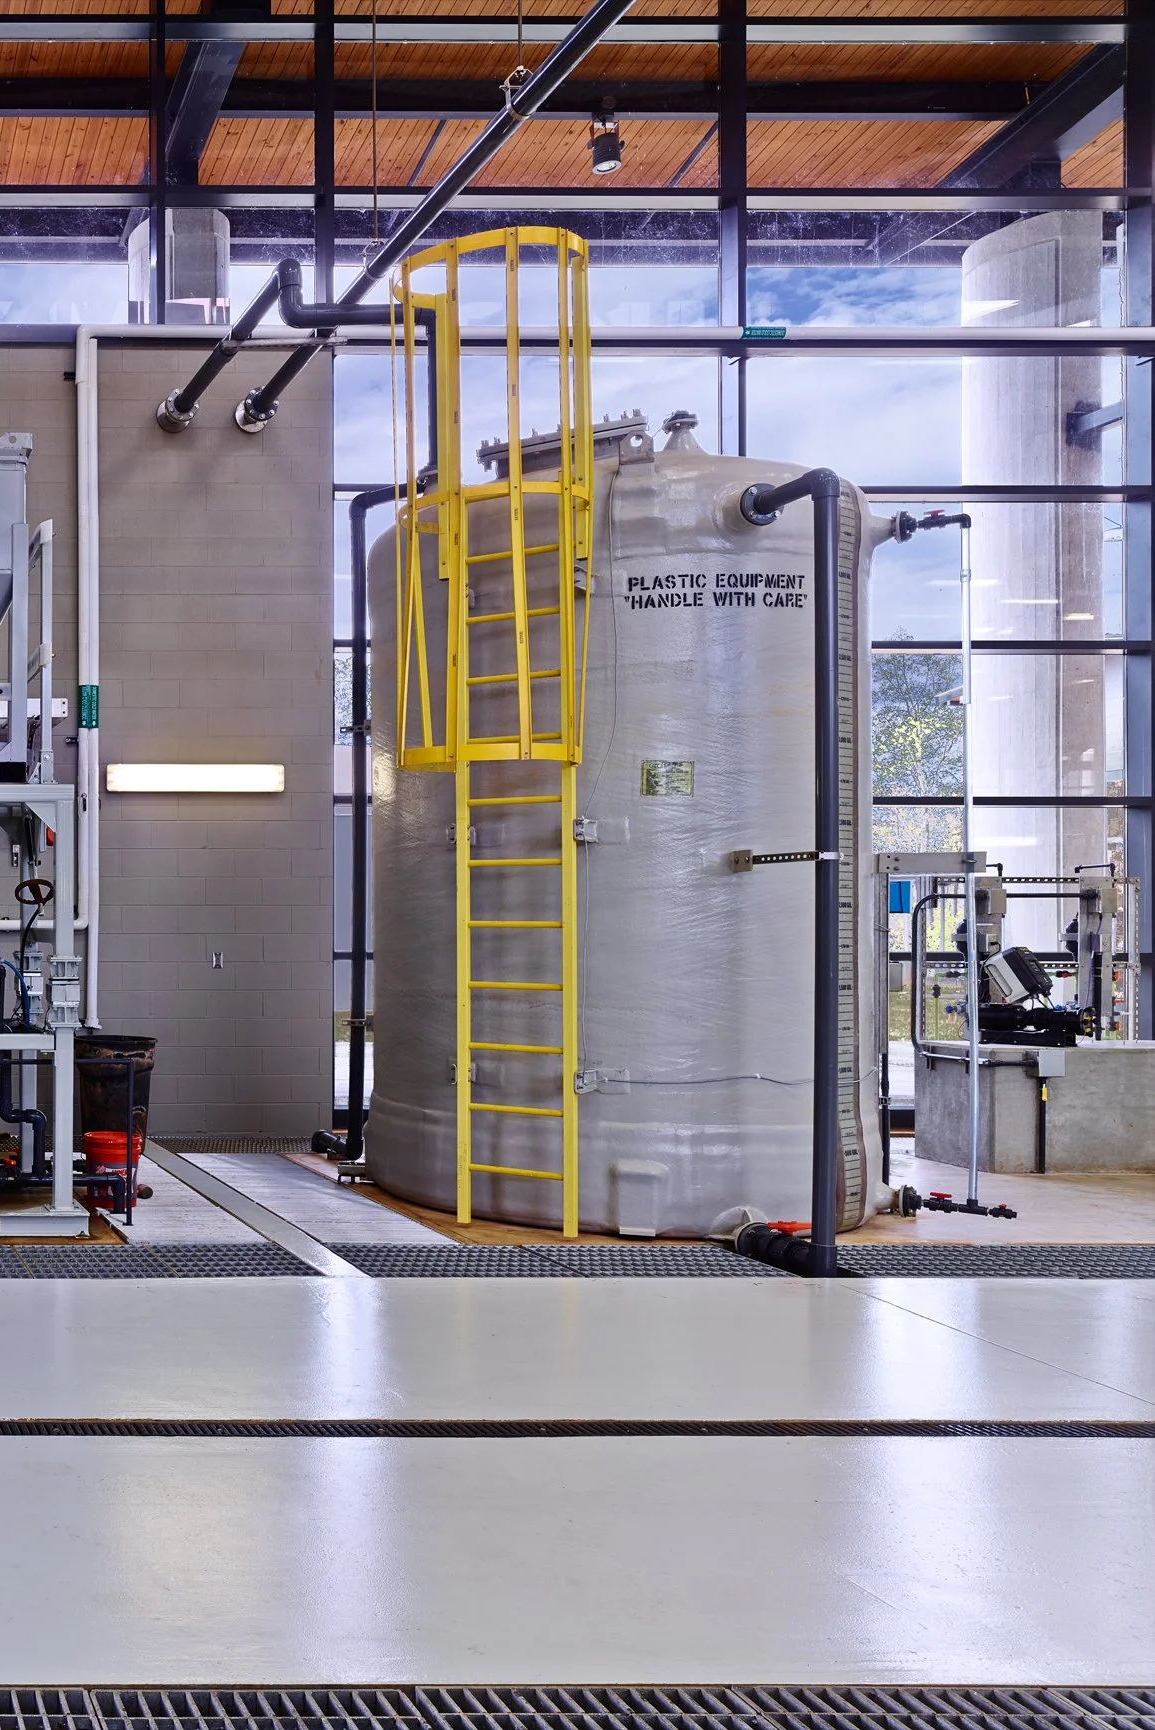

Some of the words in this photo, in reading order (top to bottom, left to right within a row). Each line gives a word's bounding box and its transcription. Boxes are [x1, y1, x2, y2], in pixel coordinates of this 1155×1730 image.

[628, 573, 707, 592] PLASTIC
[715, 573, 806, 589] EQUIPMENT
[624, 592, 704, 610] "HANDLE
[712, 591, 756, 607] WITH
[762, 592, 808, 608] CARE"
